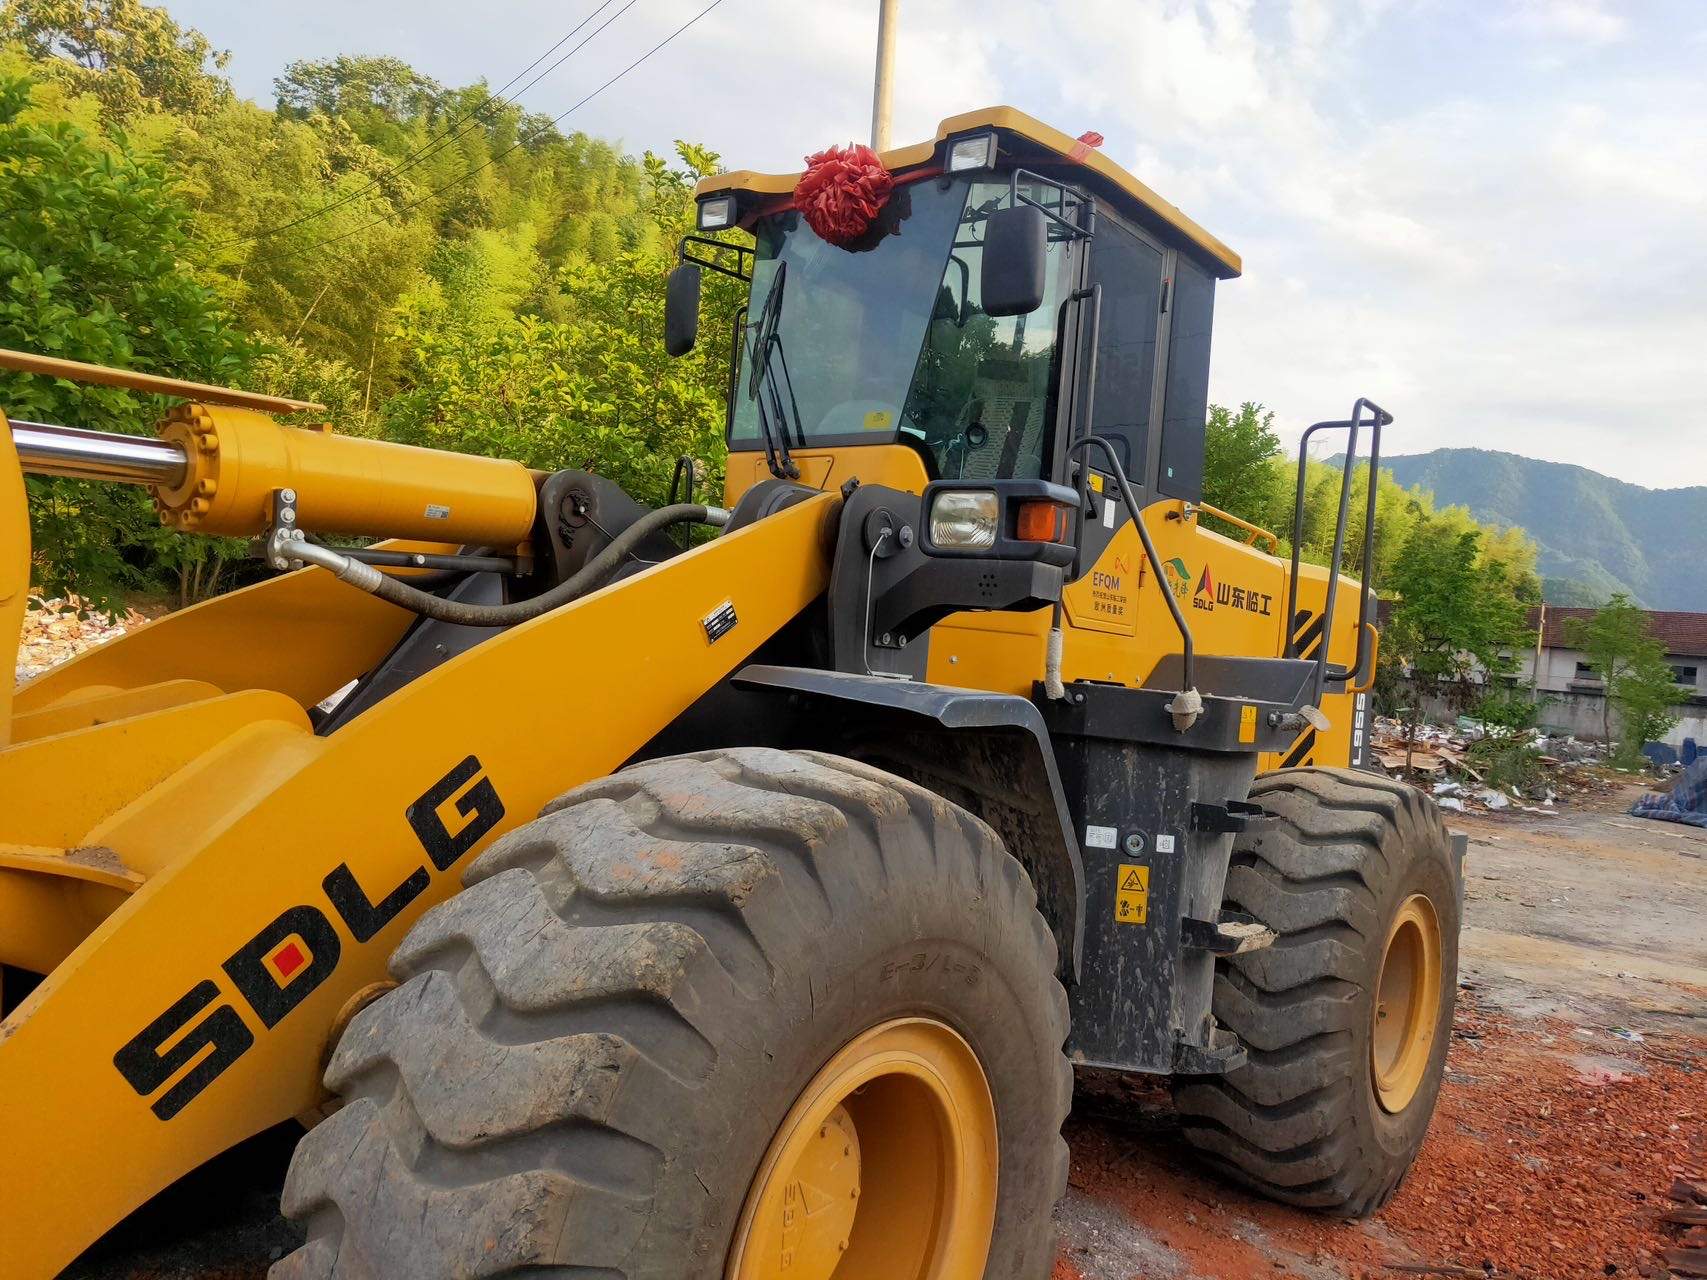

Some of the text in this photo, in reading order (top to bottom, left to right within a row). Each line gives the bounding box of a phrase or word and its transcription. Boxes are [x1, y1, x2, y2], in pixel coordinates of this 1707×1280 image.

[1092, 571, 1120, 590] EFQM
[1193, 597, 1214, 611] SDLG
[1216, 582, 1272, 616] 山东临工
[112, 754, 506, 1122] SDLG
